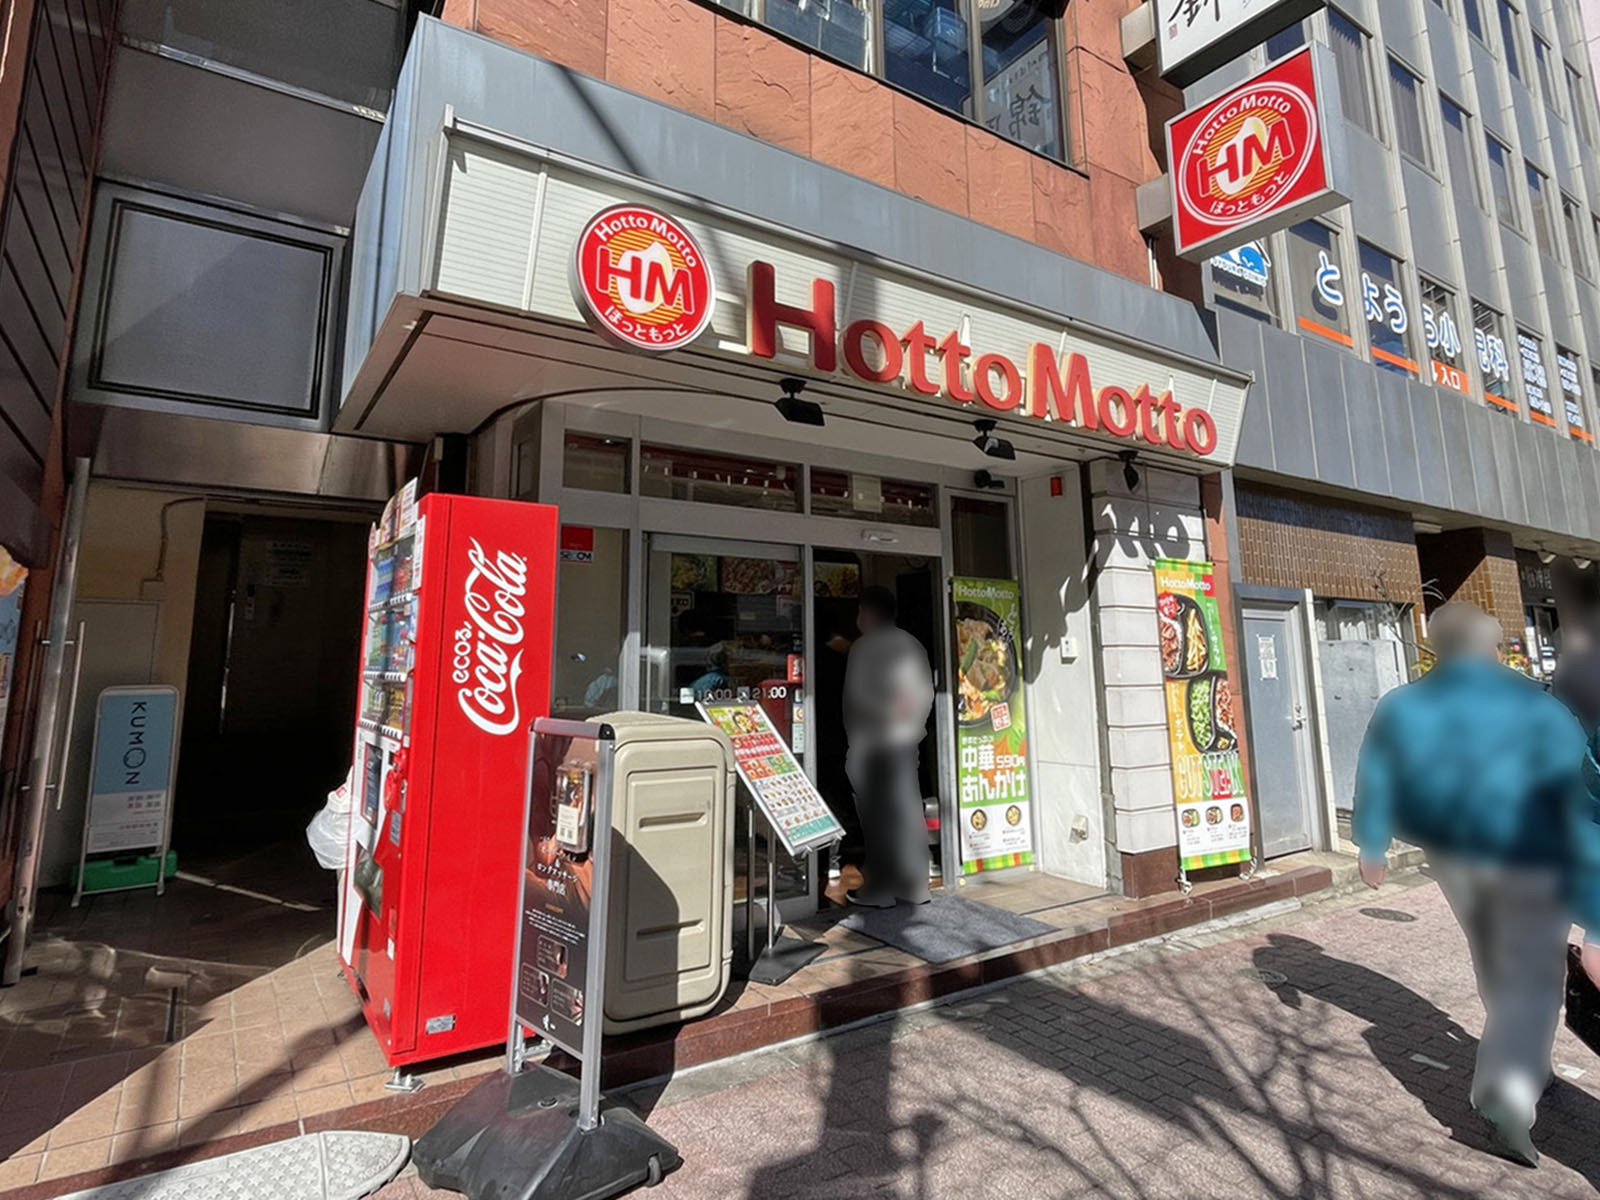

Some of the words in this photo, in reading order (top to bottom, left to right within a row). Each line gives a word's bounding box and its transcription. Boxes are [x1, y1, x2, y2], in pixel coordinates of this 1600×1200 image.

[1193, 109, 1238, 154] Hotto
[1239, 94, 1291, 113] Motto
[1209, 171, 1290, 215] ほっともっと
[594, 215, 648, 242] Hotto
[650, 218, 697, 268] Motto
[604, 305, 688, 342] ほっともっと
[458, 536, 528, 736] Coca-Cola
[123, 701, 147, 785] KUMON
[962, 745, 995, 773] 中華
[961, 769, 1026, 803] あんかけ
